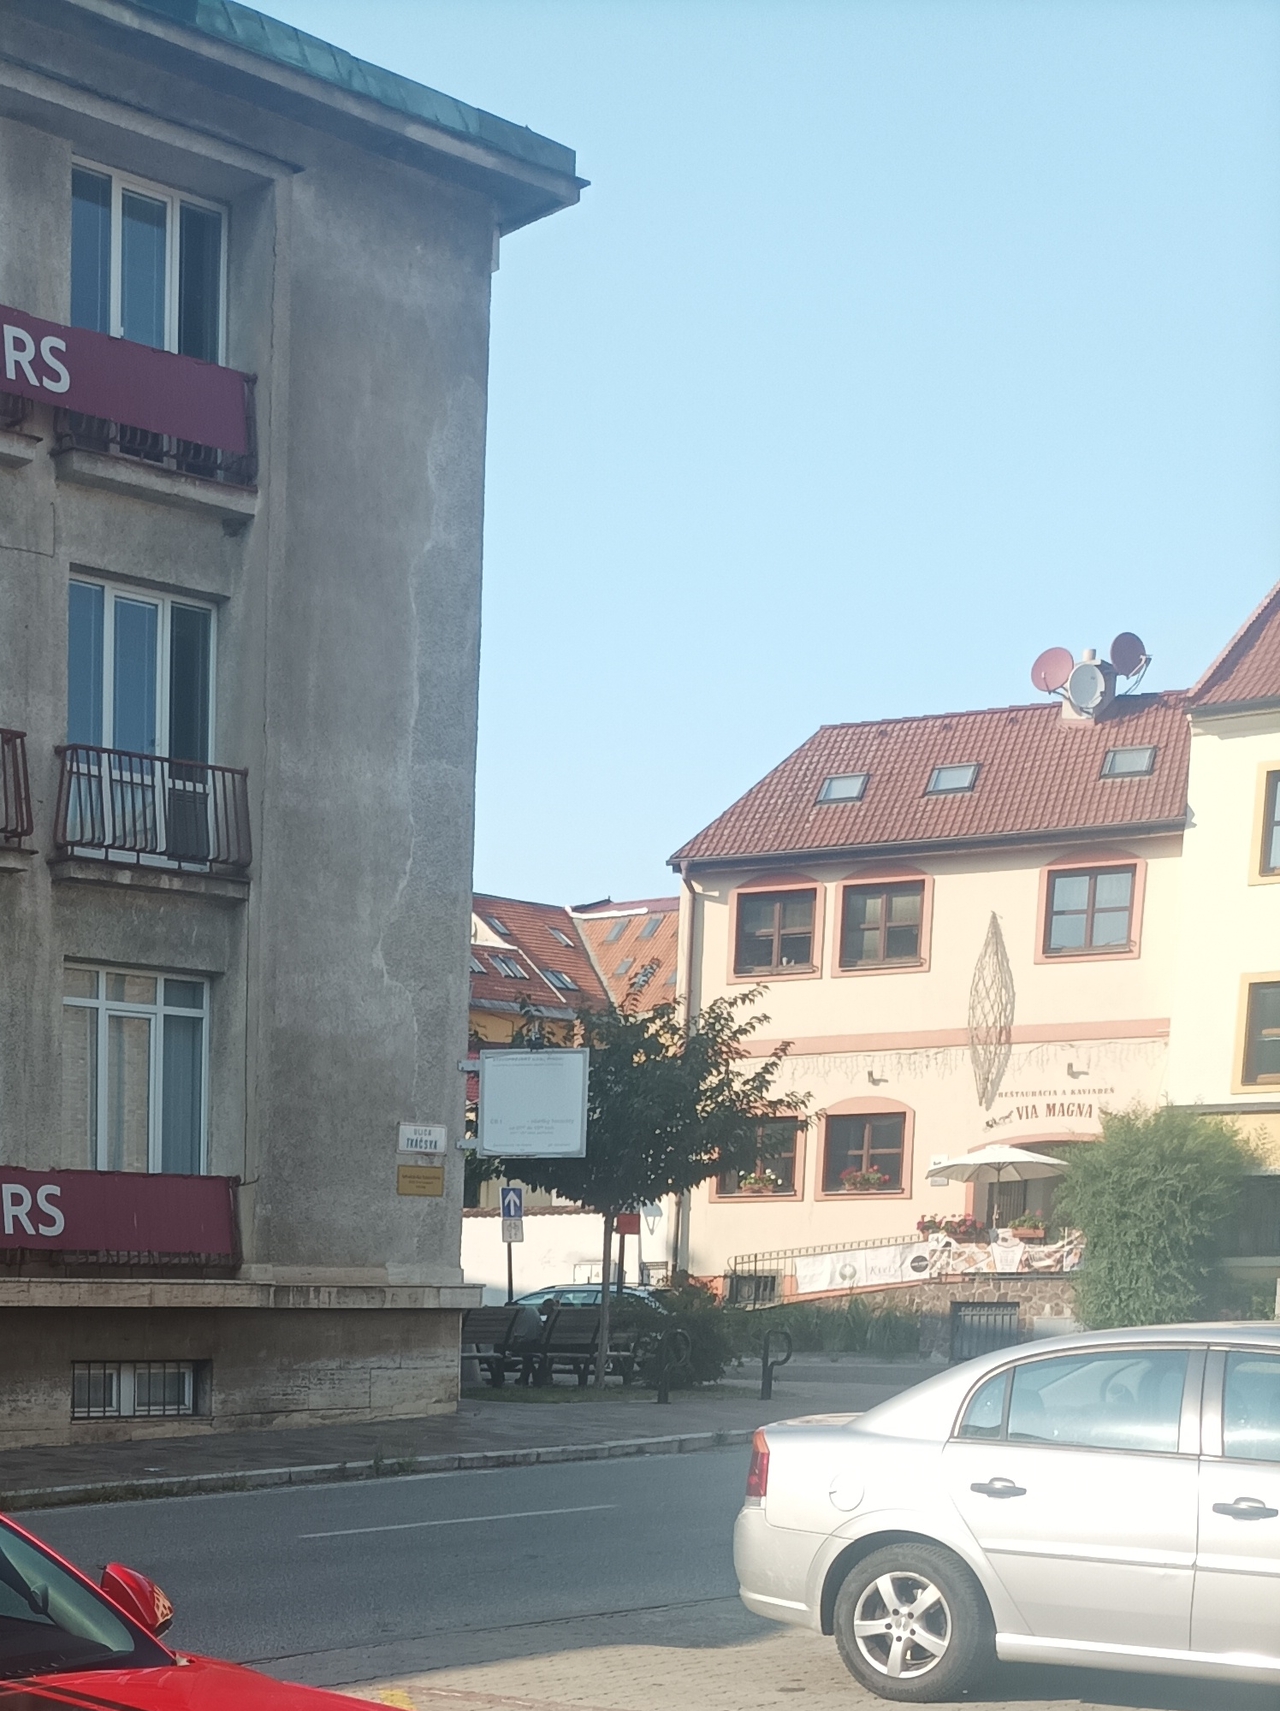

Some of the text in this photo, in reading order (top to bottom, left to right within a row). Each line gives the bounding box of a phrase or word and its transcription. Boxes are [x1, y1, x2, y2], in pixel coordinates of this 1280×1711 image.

[1016, 1102, 1093, 1120] VIA MAGNA
[406, 1136, 438, 1150] TKÁČSKA
